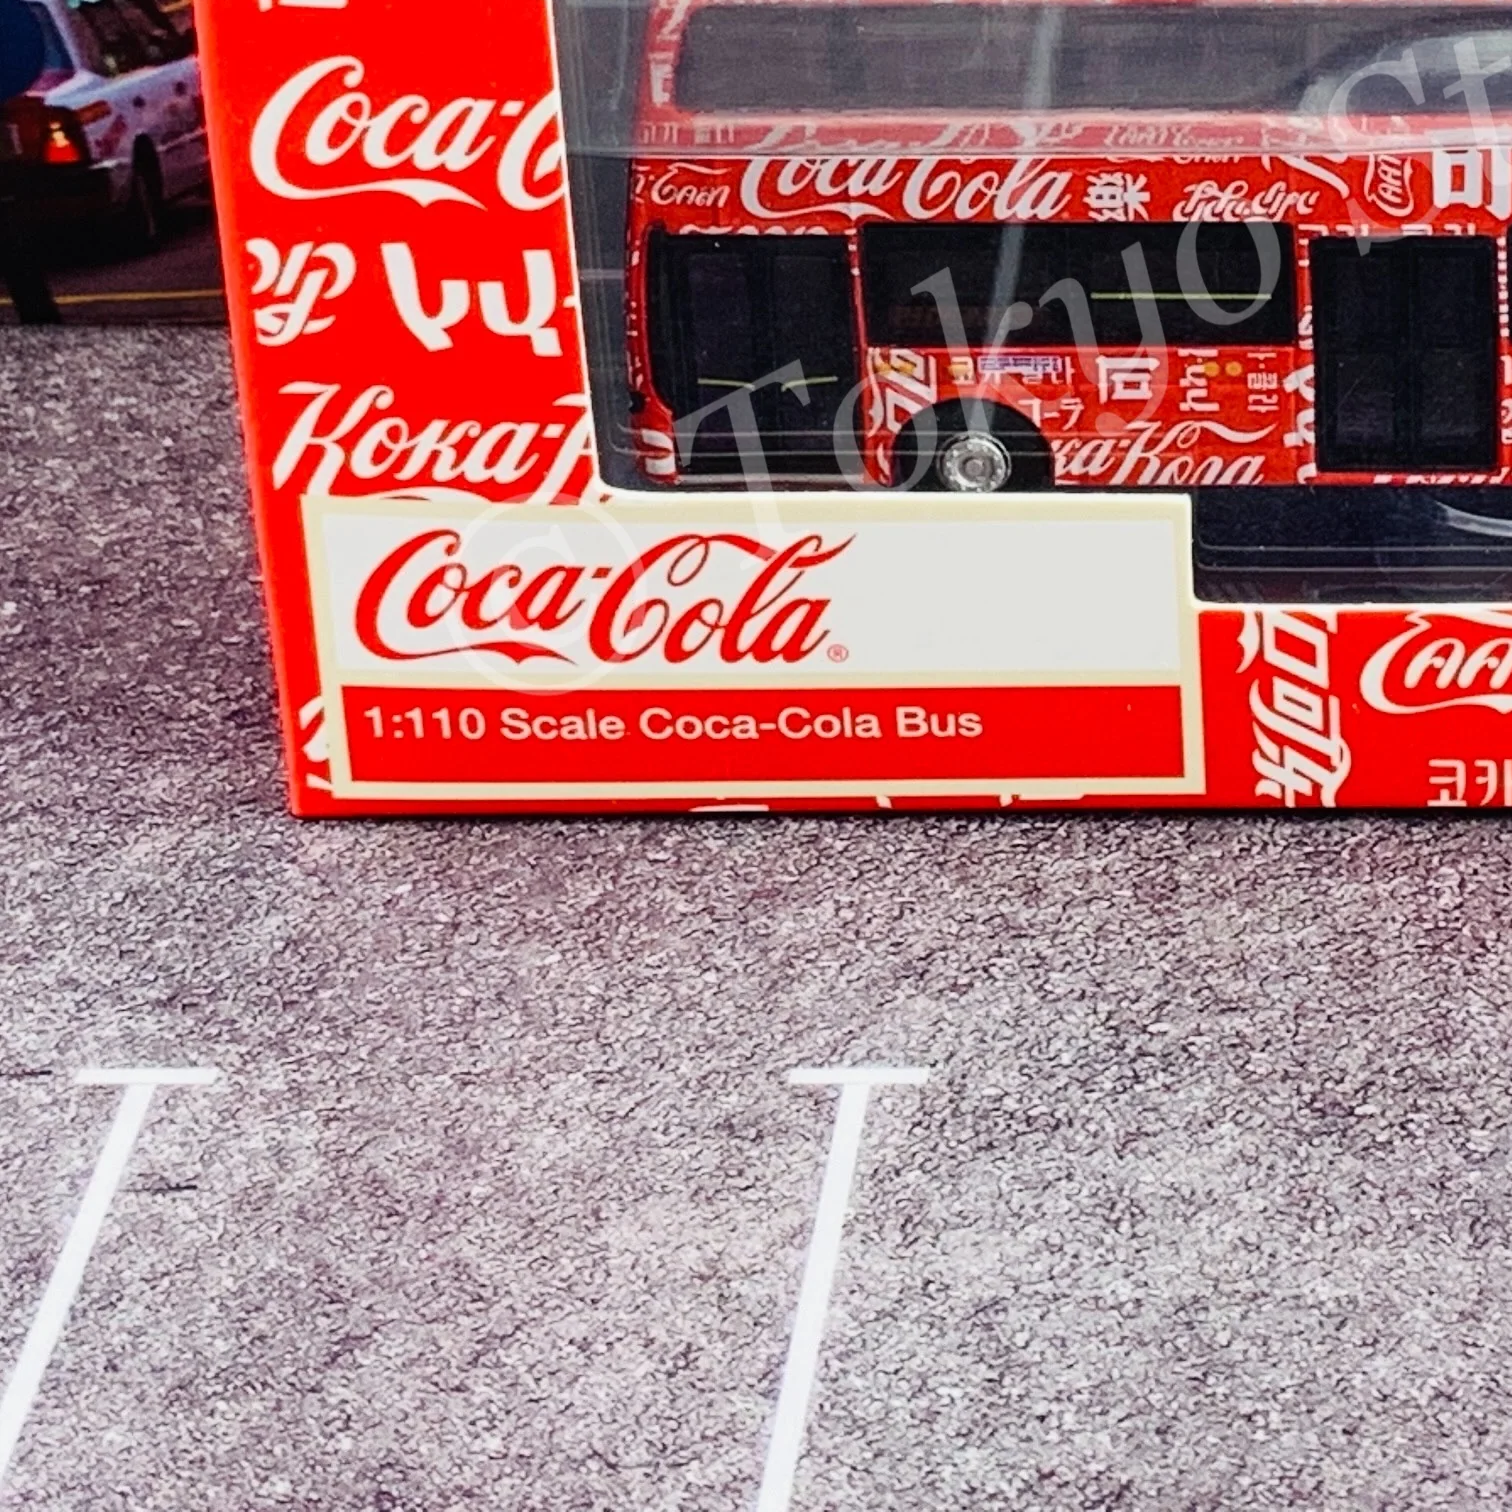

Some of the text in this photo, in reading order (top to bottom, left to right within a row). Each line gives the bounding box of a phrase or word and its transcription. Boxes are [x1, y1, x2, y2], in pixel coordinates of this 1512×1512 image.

[740, 120, 1074, 220] Coca-Cola
[353, 528, 858, 669] Coca-Cola
[364, 704, 984, 742] 1:110 Scale Coca-Cola Bus
